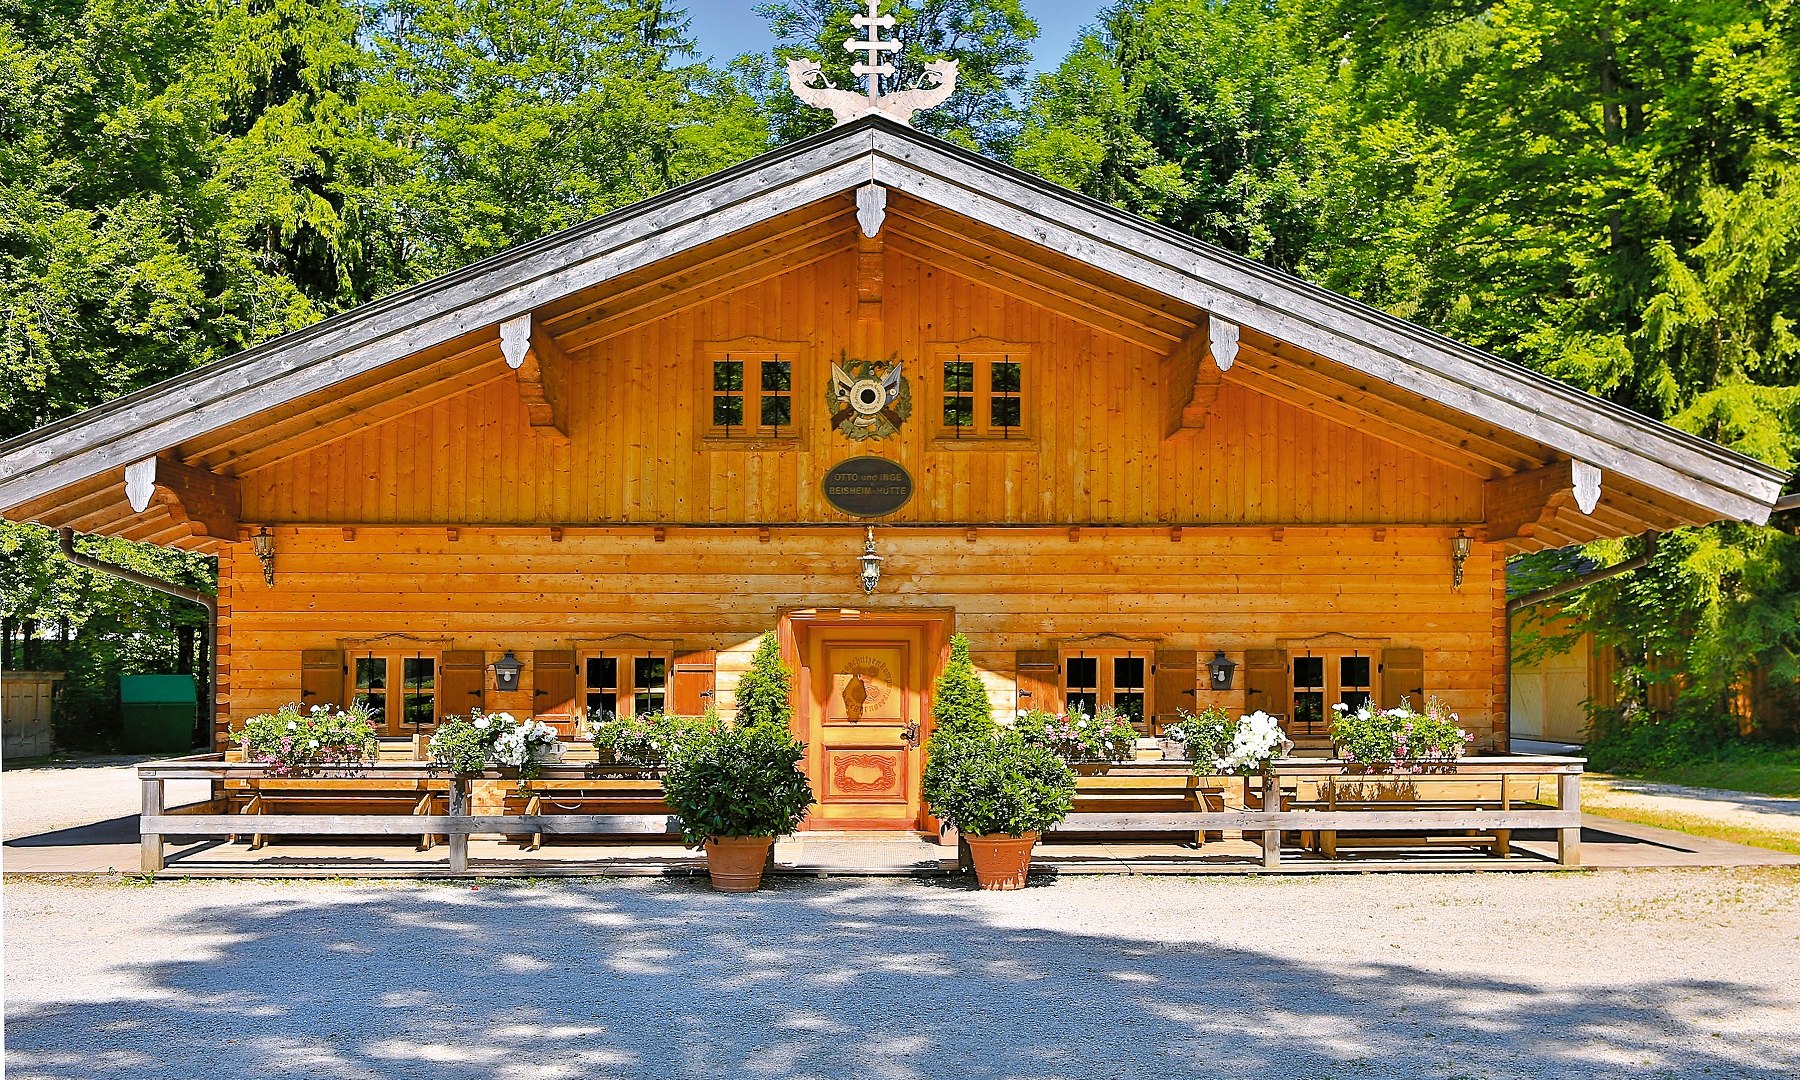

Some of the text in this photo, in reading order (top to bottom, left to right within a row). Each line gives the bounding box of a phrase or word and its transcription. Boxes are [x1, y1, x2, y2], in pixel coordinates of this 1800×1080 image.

[834, 473, 902, 482] OTTO und INGE
